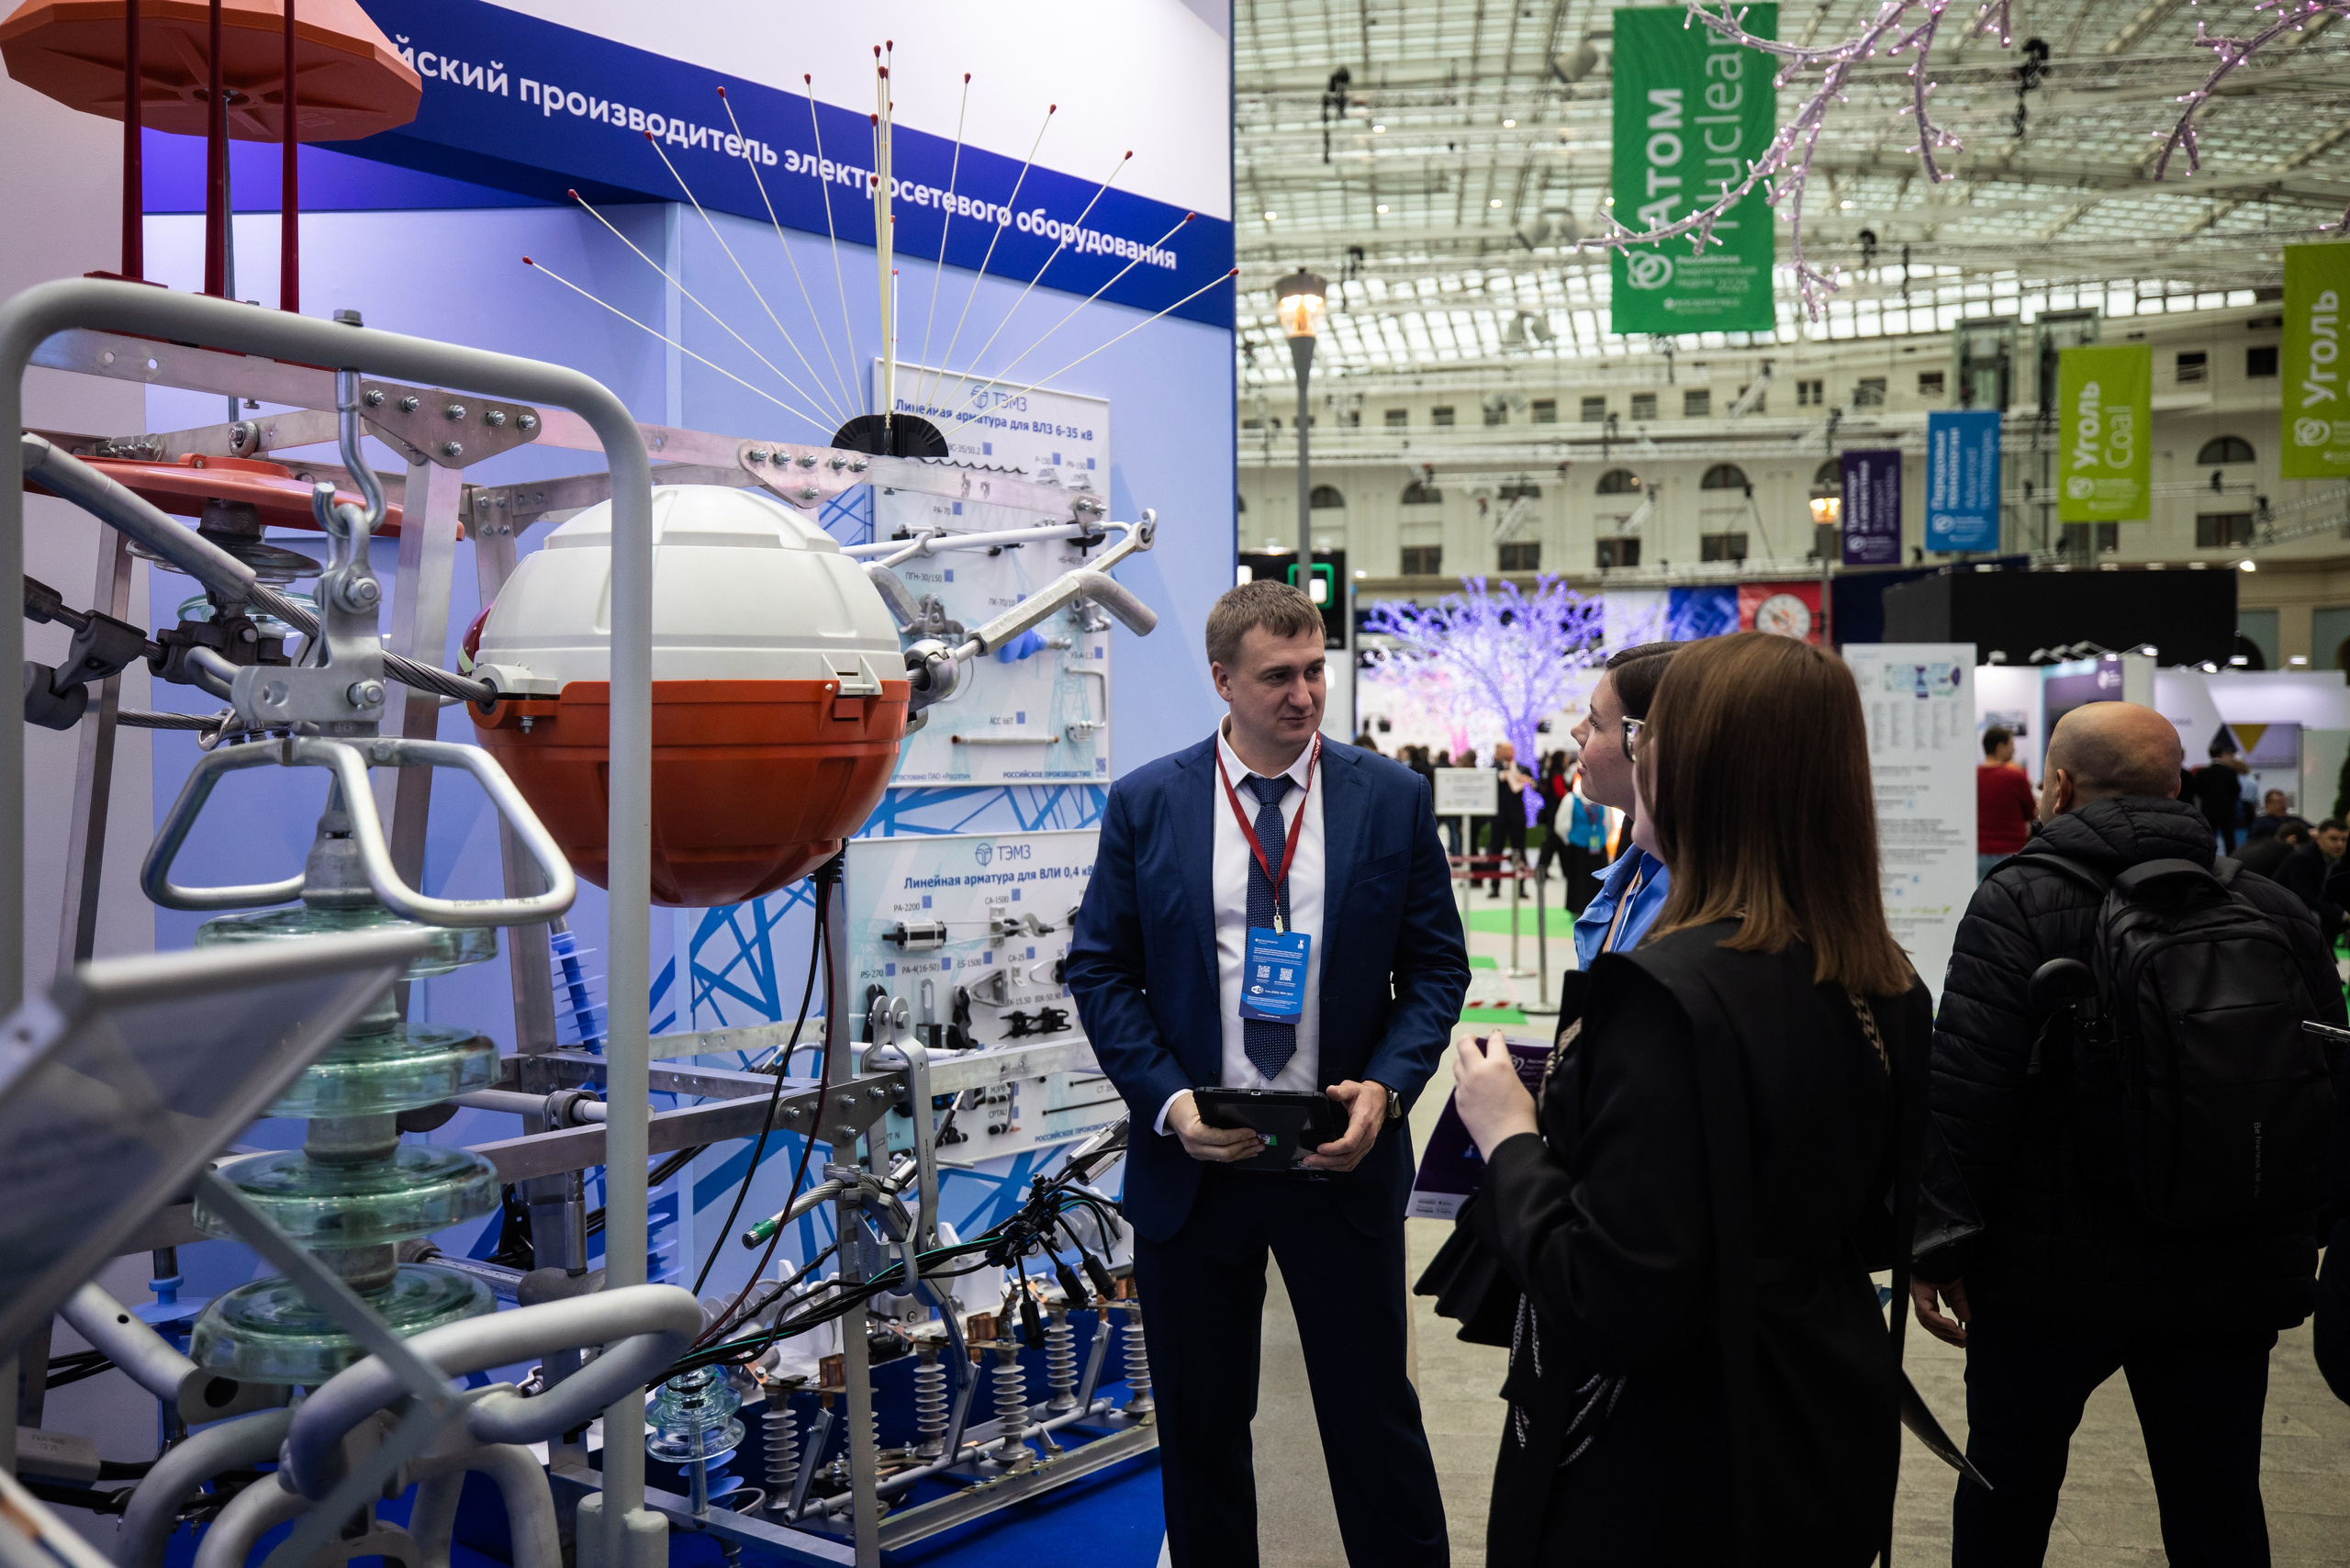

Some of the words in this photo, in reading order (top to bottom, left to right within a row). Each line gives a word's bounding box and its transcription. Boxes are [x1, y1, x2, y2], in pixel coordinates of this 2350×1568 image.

[392, 34, 509, 97] йский
[520, 77, 778, 166] производитель
[784, 150, 1013, 228] электросетевого
[1015, 207, 1177, 270] оборудования
[2302, 289, 2339, 409] Уголь
[992, 391, 1028, 412] ТЭМЗ
[895, 398, 953, 419] Линейная
[956, 411, 1007, 429] арматура
[1010, 420, 1029, 431] для
[1056, 425, 1078, 439] 6-35
[1081, 430, 1093, 441] кВ
[2072, 380, 2101, 471] Уголь
[2105, 405, 2135, 469] Coal
[1002, 769, 1044, 778] РОССИЙСКОЕ
[1045, 769, 1091, 778] ПРОИЗВОДСТВО
[996, 844, 1031, 861] ТЭМЗ
[904, 874, 961, 890] Линейная
[964, 871, 1015, 888] арматура
[1017, 870, 1036, 882] для
[1039, 868, 1061, 879] ВЛИ
[1064, 866, 1079, 879] 0,4
[1082, 865, 1093, 876] кВ
[860, 969, 884, 979] PS-270
[957, 958, 981, 969] ES-1500
[1035, 1129, 1074, 1143] РОССИЙСКОЕ
[1075, 1119, 1121, 1135] ПРОИЗВОДСТ
[2254, 1122, 2262, 1135] Be
[2255, 1172, 2263, 1182] be
